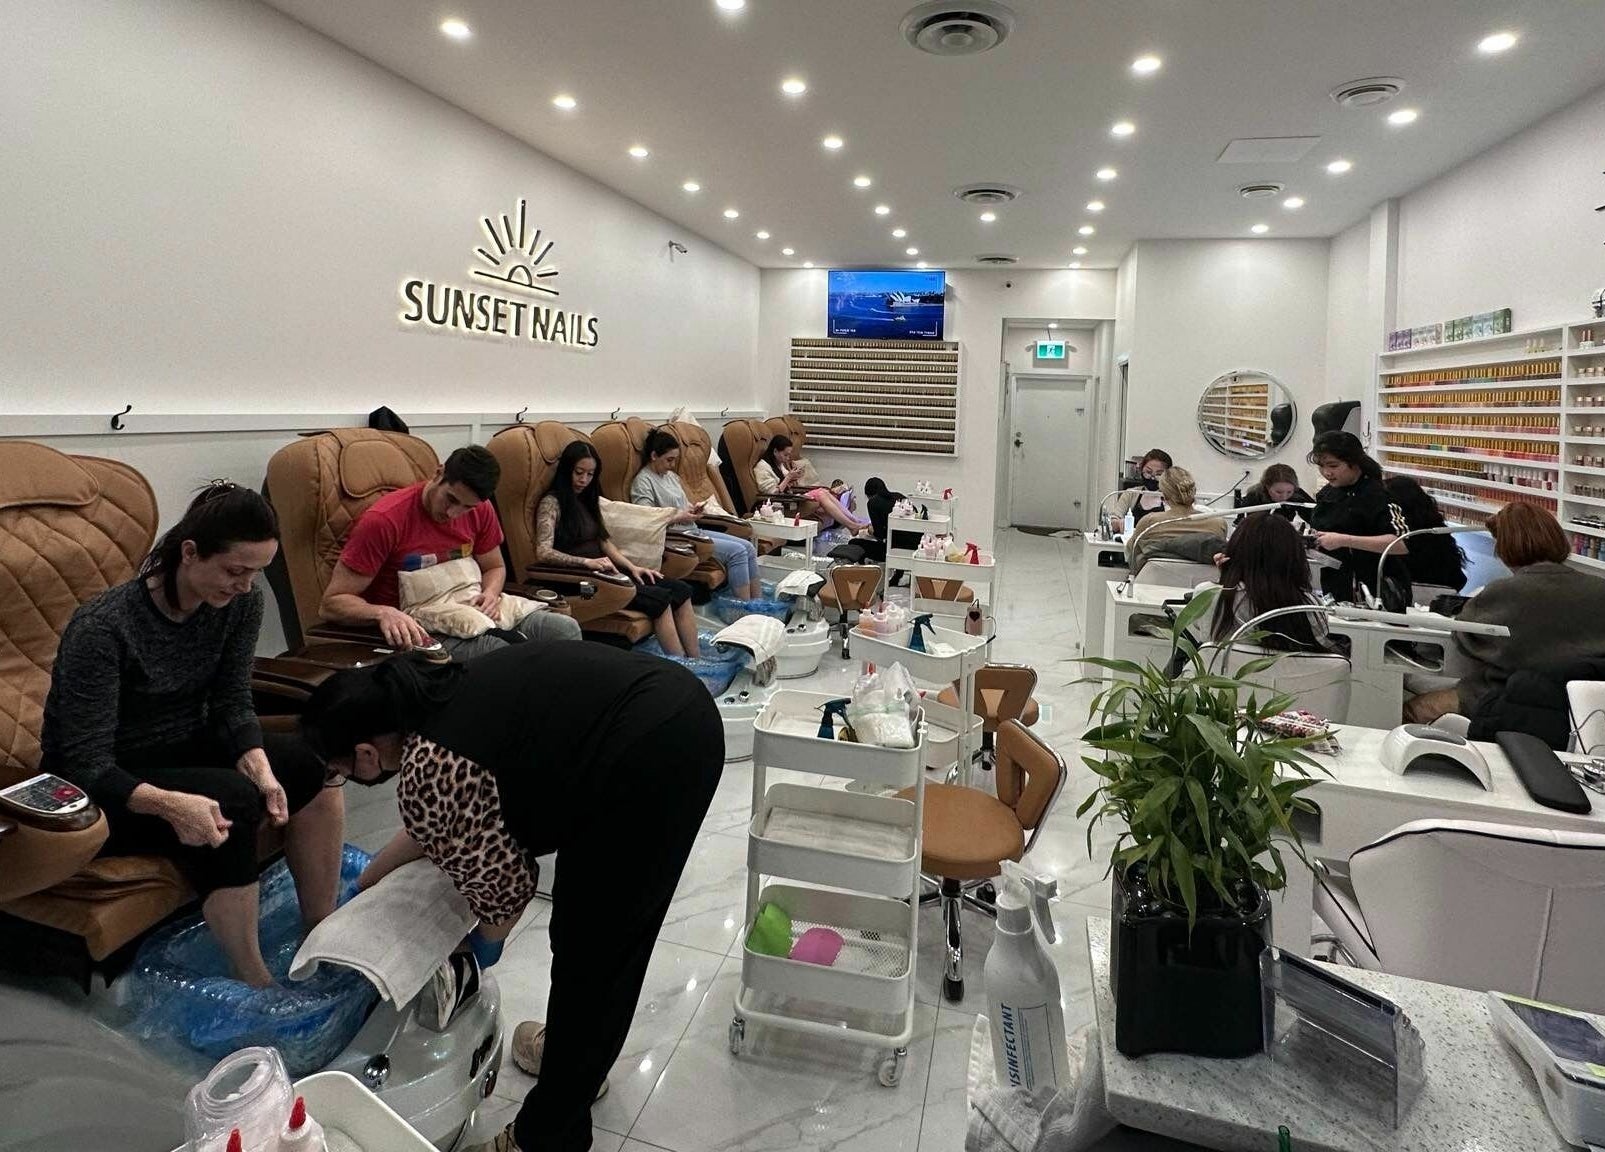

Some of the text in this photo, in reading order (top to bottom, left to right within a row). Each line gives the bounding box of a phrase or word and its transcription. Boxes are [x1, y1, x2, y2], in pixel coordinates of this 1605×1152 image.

[404, 280, 599, 347] SUNSET NAILS
[1001, 1003, 1022, 1087] ISINFECTANT
